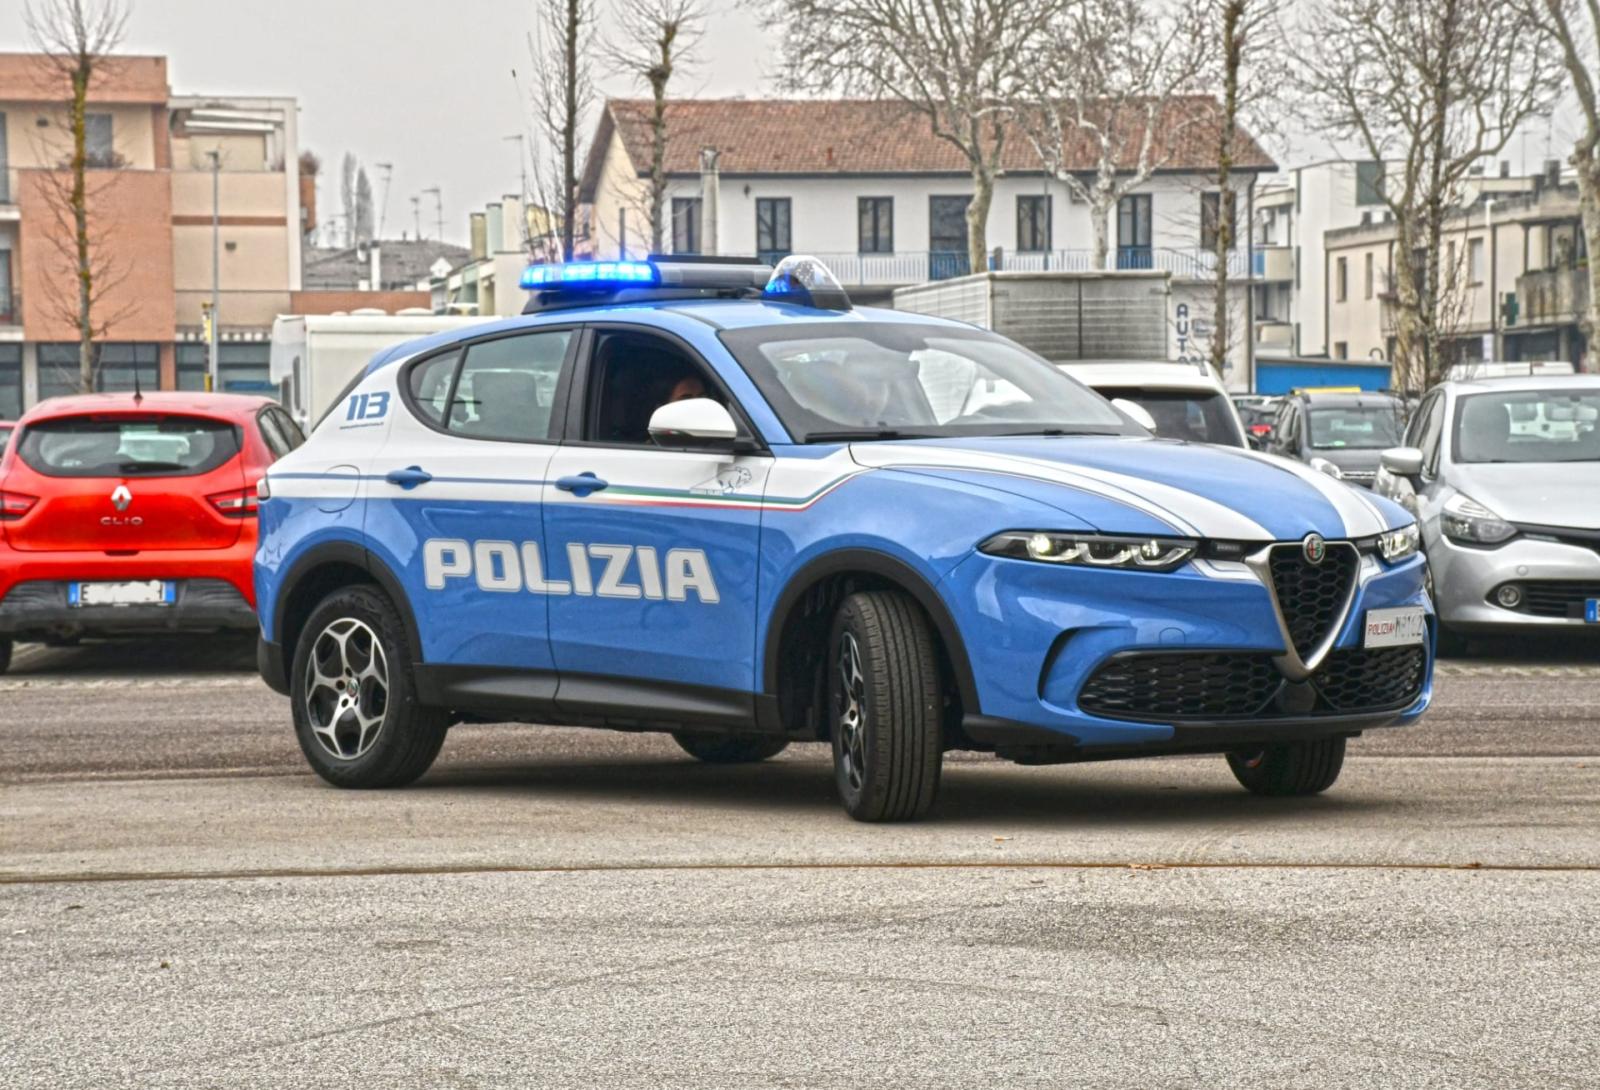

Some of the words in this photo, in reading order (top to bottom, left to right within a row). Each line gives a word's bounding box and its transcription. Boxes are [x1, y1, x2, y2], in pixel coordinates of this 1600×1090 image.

[346, 391, 390, 421] 113
[100, 516, 143, 525] CLIO
[423, 538, 721, 604] POLIZIA
